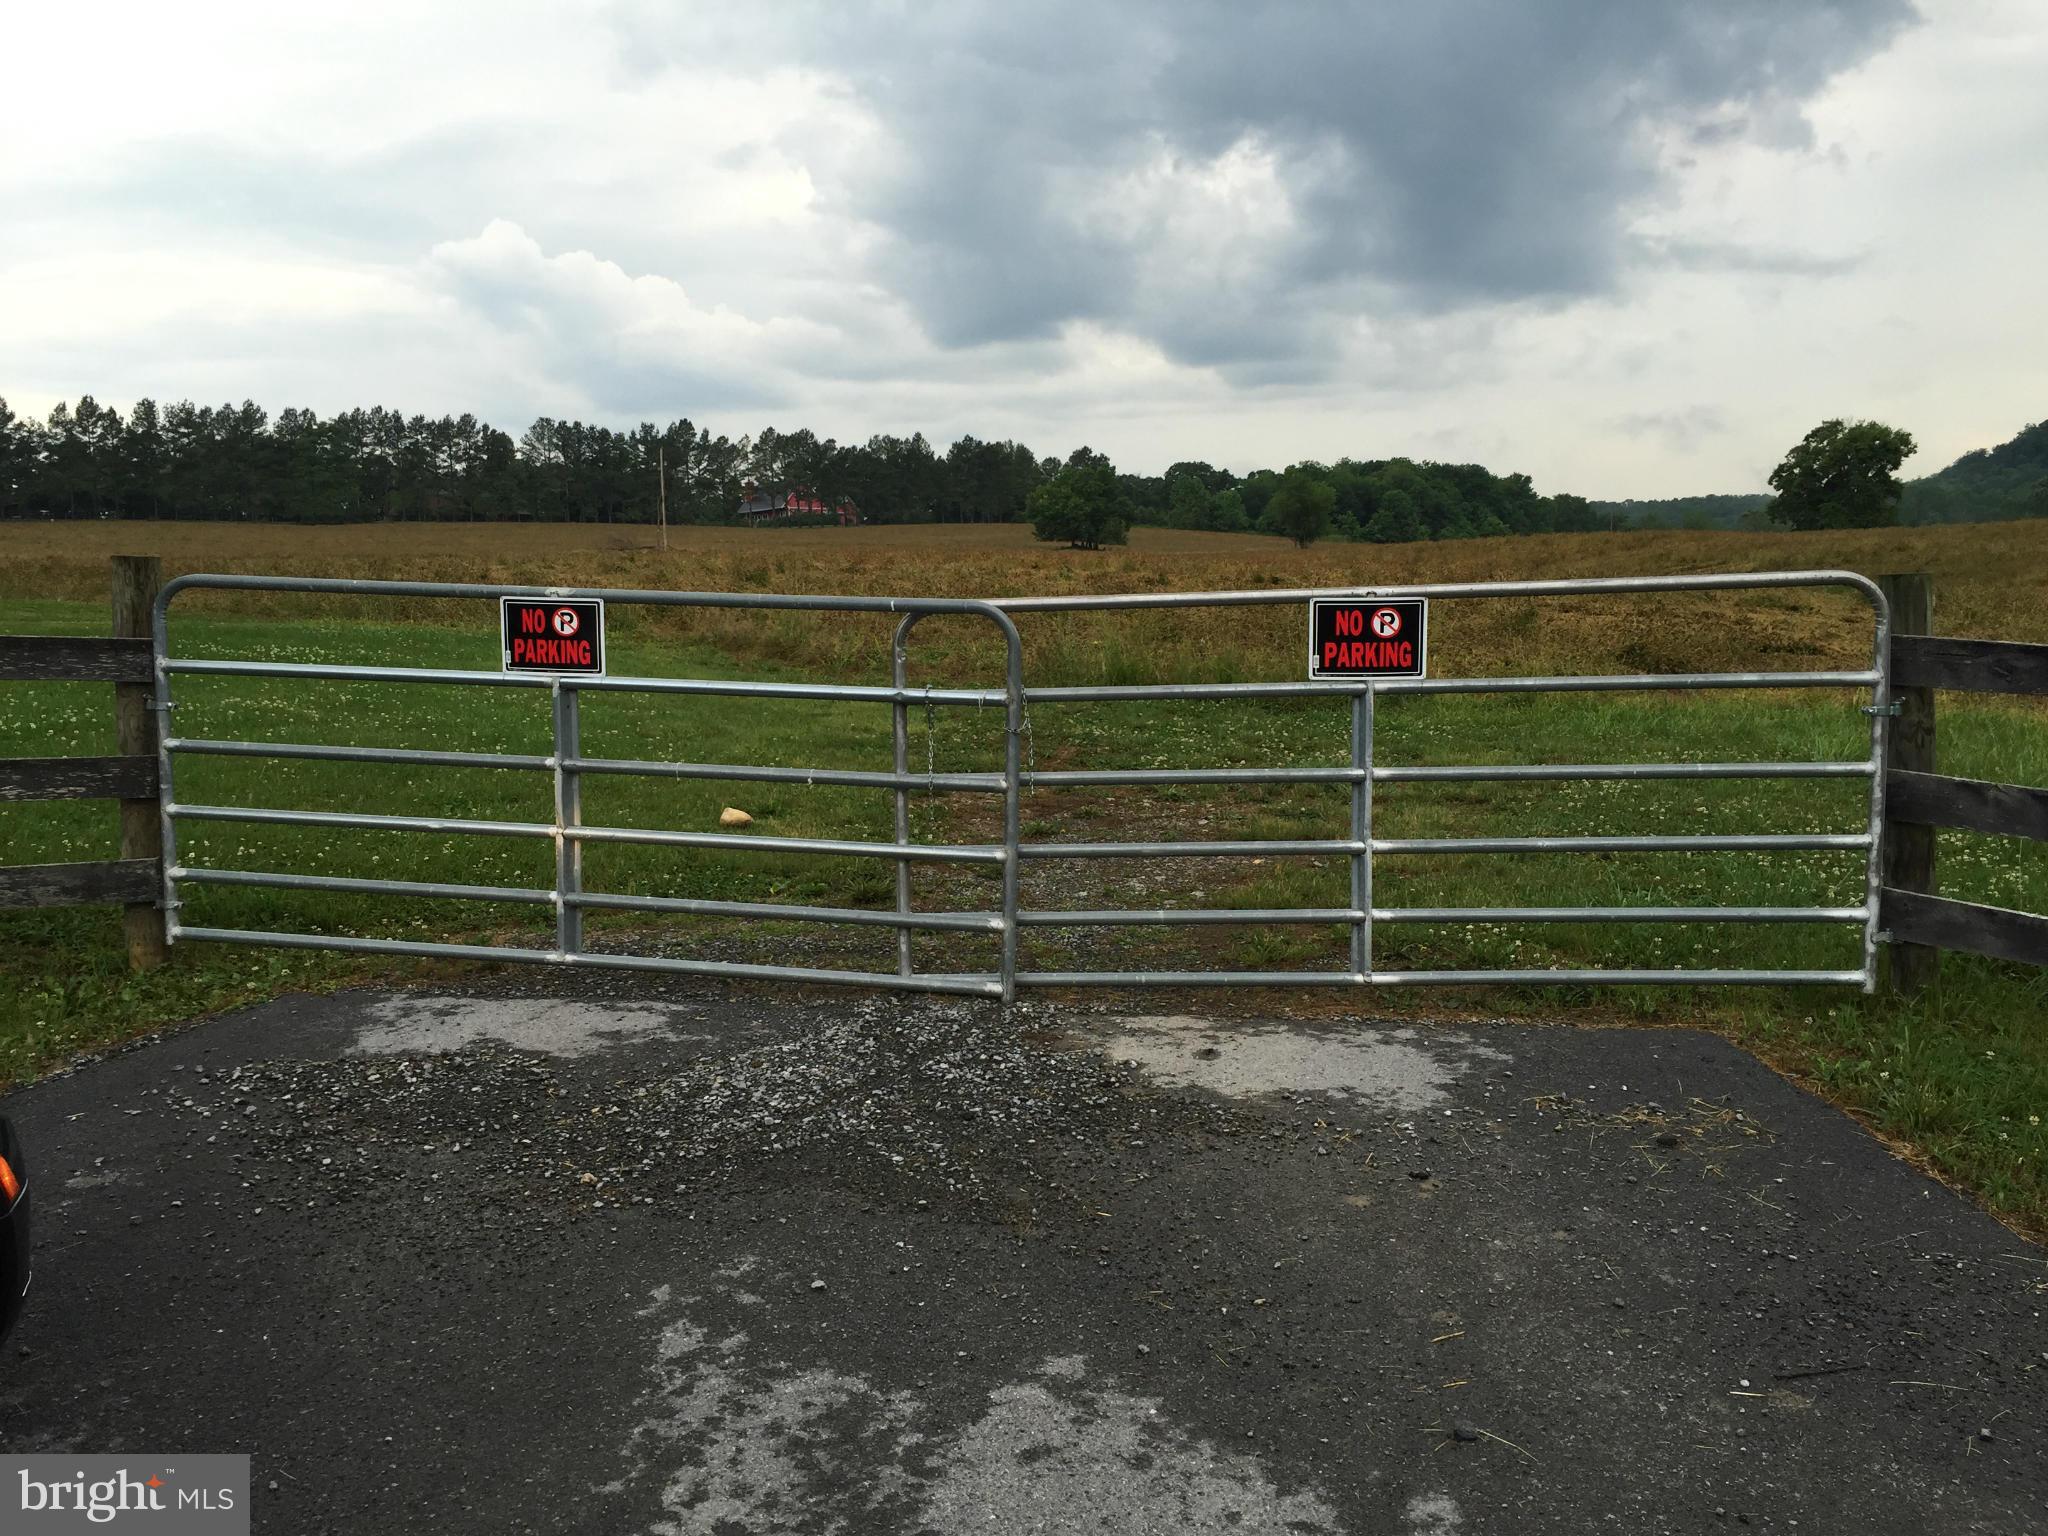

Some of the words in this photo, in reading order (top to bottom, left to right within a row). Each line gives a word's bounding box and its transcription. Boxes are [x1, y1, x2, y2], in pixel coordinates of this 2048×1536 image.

[521, 608, 546, 633] NO
[1335, 609, 1363, 636] NO
[514, 638, 591, 665] PARKING
[1324, 640, 1412, 668] PARKING
